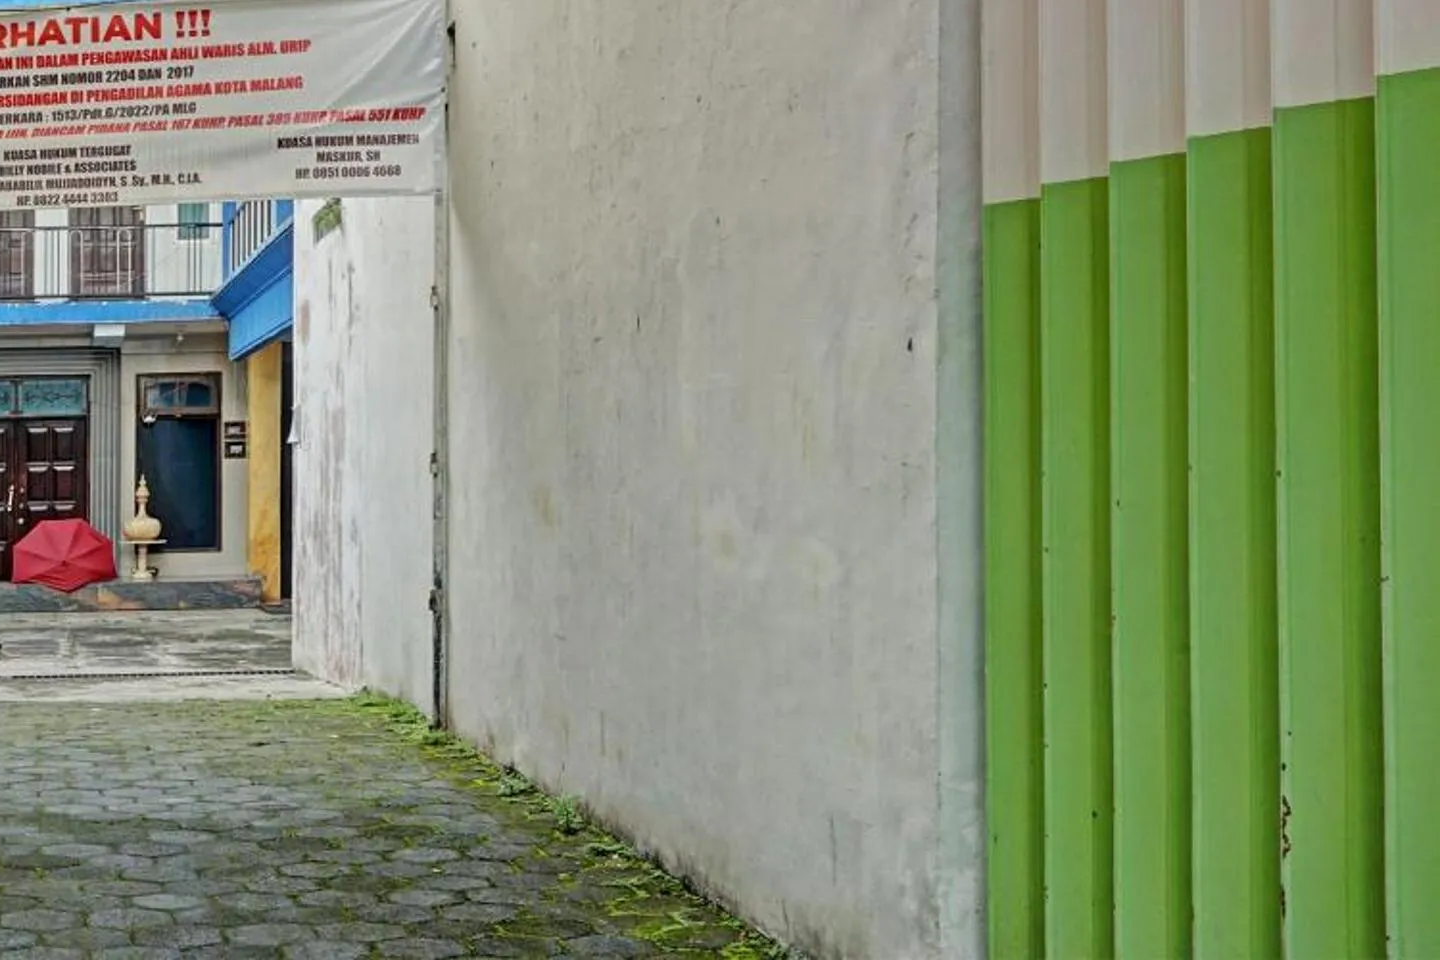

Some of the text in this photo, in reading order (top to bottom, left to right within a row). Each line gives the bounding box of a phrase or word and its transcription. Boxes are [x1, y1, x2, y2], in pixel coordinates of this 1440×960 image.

[175, 9, 211, 38] !!!
[16, 55, 34, 69] INI
[36, 53, 79, 69] DALAM
[81, 48, 168, 67] PENGAWASAN
[170, 46, 199, 61] AHLI
[201, 43, 245, 59] WARIS
[247, 40, 277, 56] ALM.
[280, 39, 312, 54] URIP
[32, 72, 59, 88] SHM
[61, 70, 103, 86] NOMOR
[105, 68, 135, 83] 2204
[137, 68, 162, 81] DAN
[166, 64, 195, 80] 2017
[70, 89, 84, 104] DI
[86, 84, 164, 102] PENGADILAN
[166, 82, 212, 98] AGAMA
[214, 79, 247, 94] KOTA
[249, 75, 304, 92] MALANG
[172, 102, 197, 115] MLG
[31, 124, 87, 137] DIANCAM
[88, 122, 132, 134] PIDANA
[132, 120, 168, 132] PASAL
[228, 113, 265, 128] PASAL
[391, 105, 426, 121] KUHP
[3, 144, 132, 161] KUASA HUKUM TERGUGAT
[277, 133, 420, 149] KUASA HUKUM MANAJEMEN
[63, 163, 72, 174] &
[73, 159, 138, 174] ASSOCIATES
